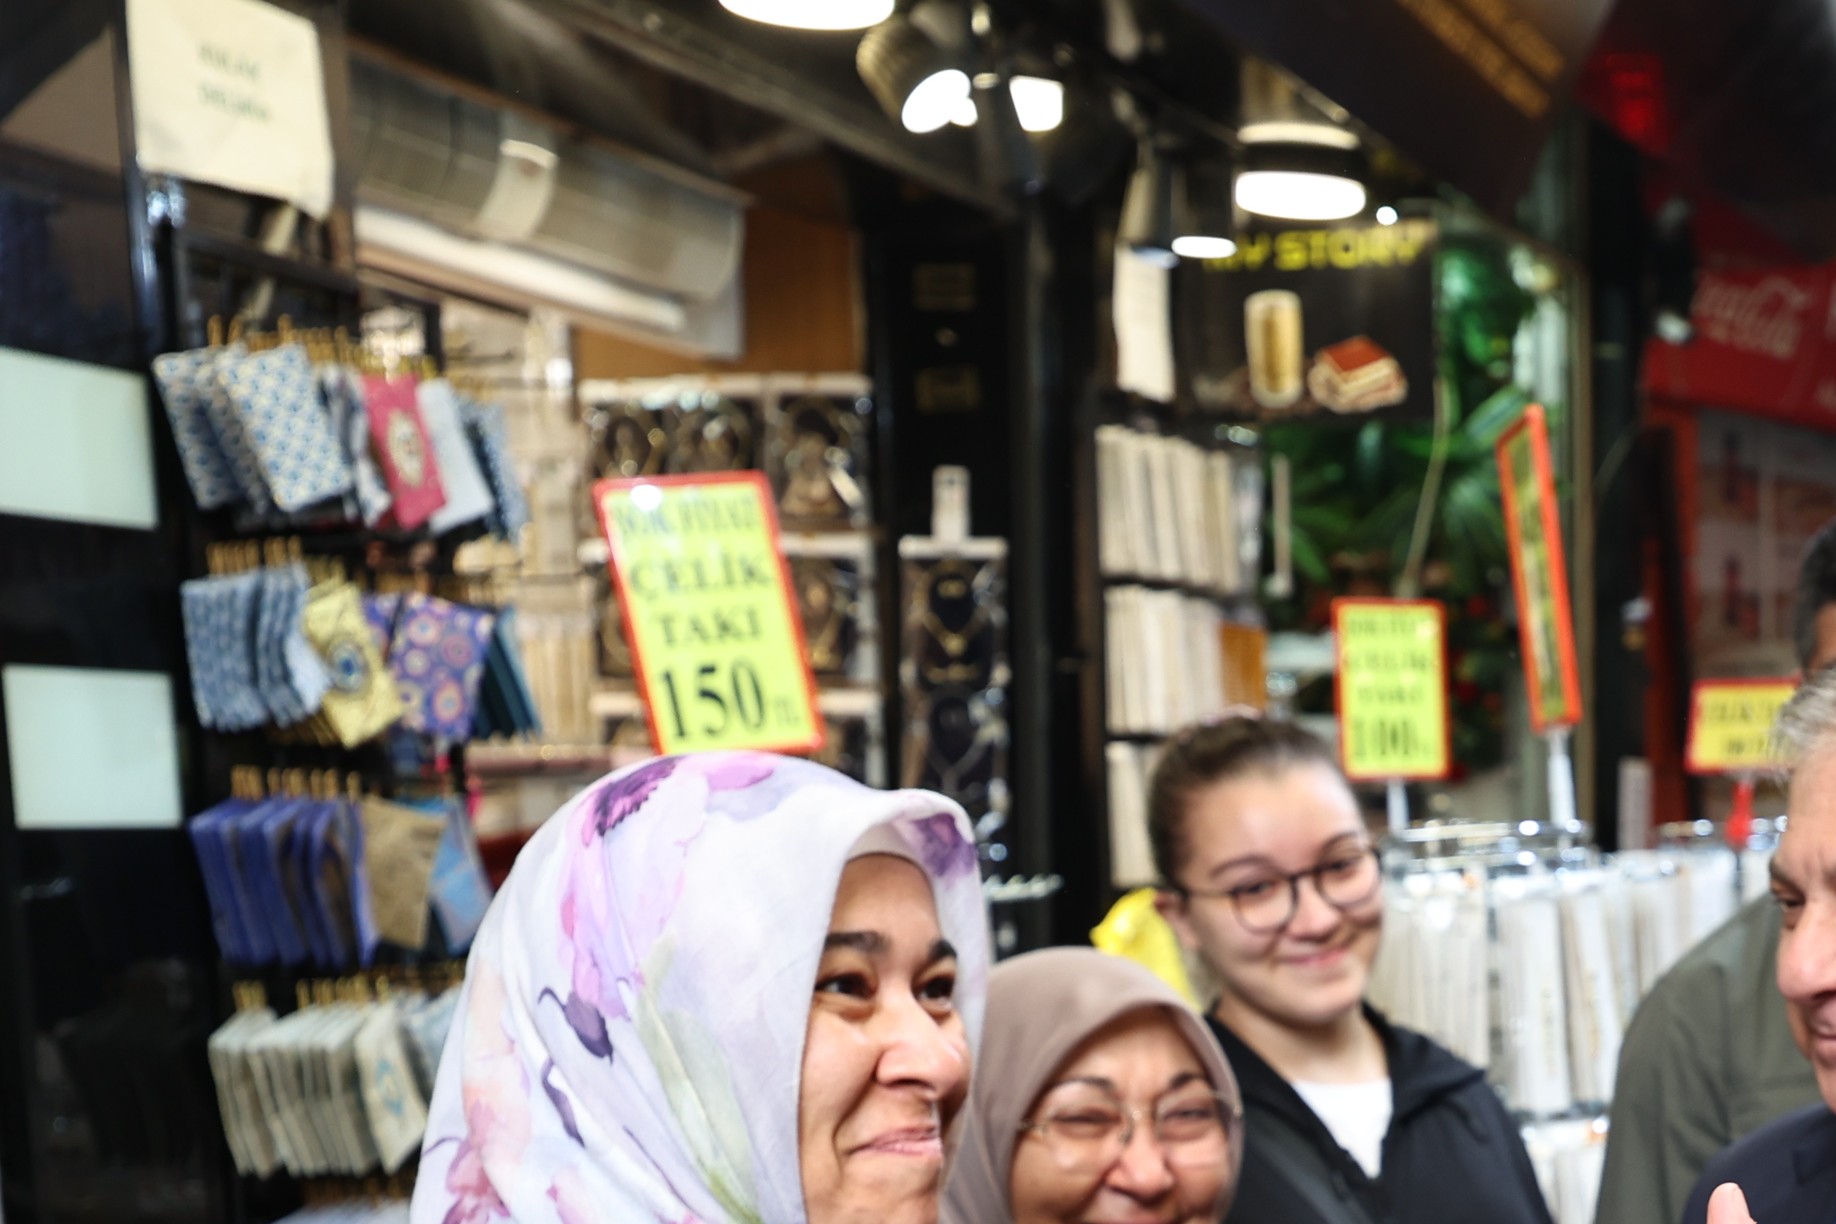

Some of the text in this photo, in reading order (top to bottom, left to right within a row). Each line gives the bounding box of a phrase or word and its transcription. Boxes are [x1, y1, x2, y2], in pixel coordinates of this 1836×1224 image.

[1273, 219, 1436, 271] STORY
[631, 547, 771, 599] ÇELİK
[662, 660, 767, 741] 150
